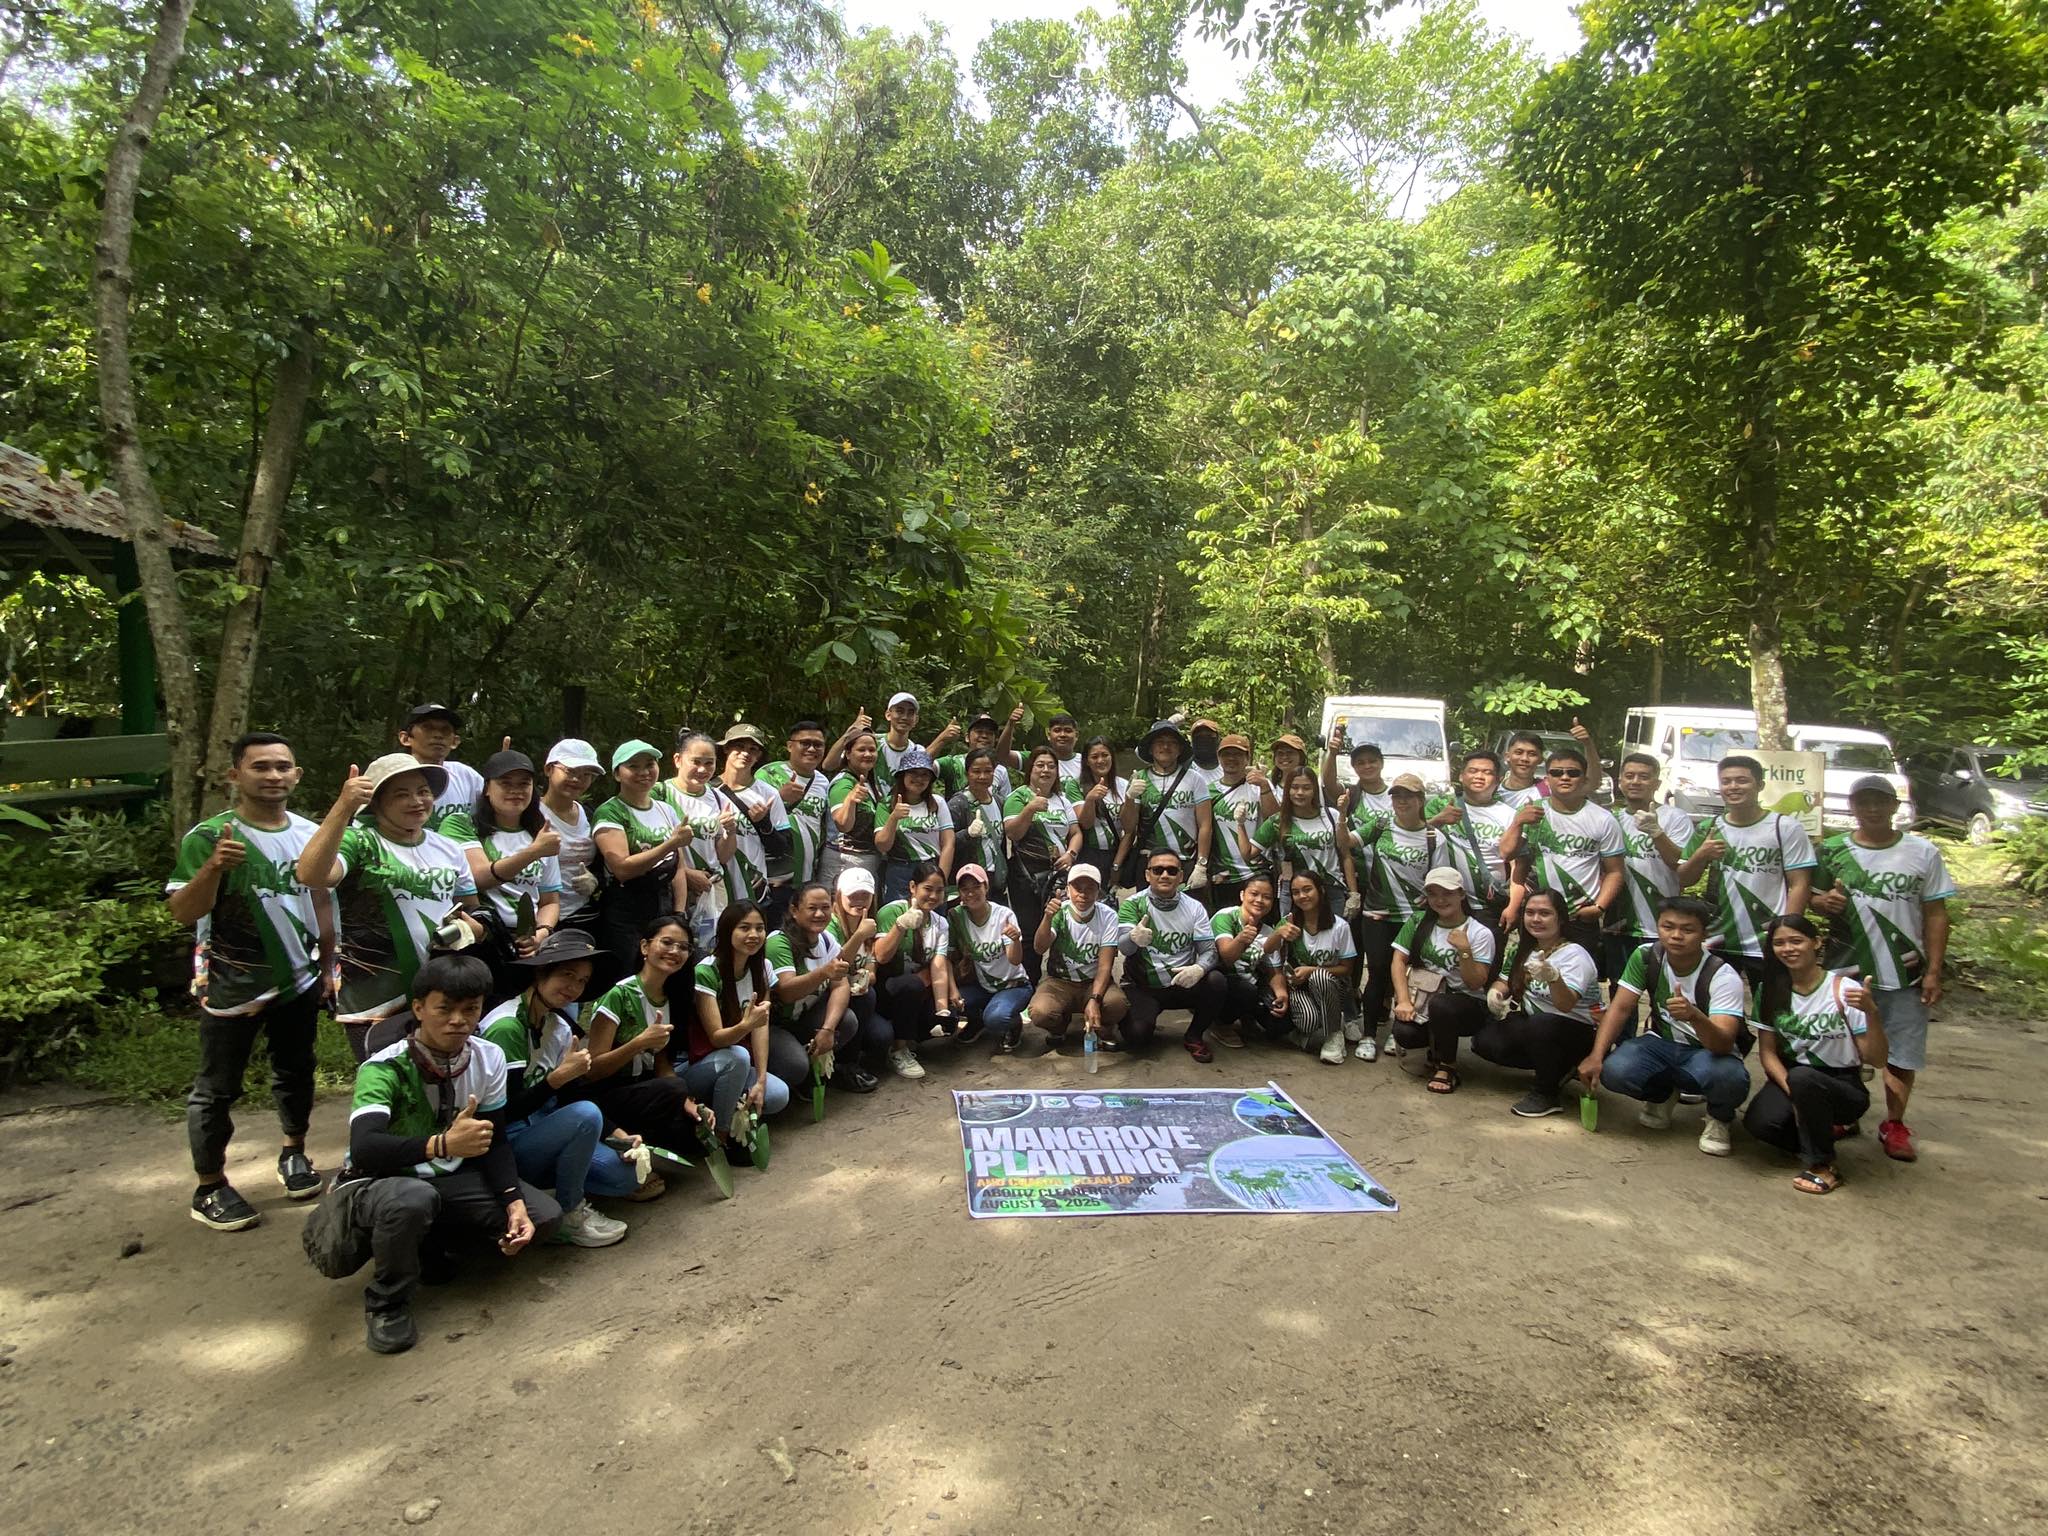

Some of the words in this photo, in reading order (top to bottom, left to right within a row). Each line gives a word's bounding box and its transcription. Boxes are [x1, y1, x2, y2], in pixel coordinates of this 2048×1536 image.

[1762, 765, 1805, 785] rking
[971, 1126, 1202, 1151] MANGROVE
[974, 1148, 1181, 1177] PLANTING
[1116, 1175, 1134, 1185] UP
[1157, 1175, 1182, 1185] THE
[982, 1188, 1034, 1198] ABOITIZ
[1120, 1186, 1157, 1196] PARK
[980, 1200, 1036, 1209] AUGUST
[1064, 1198, 1101, 1208] 2025
